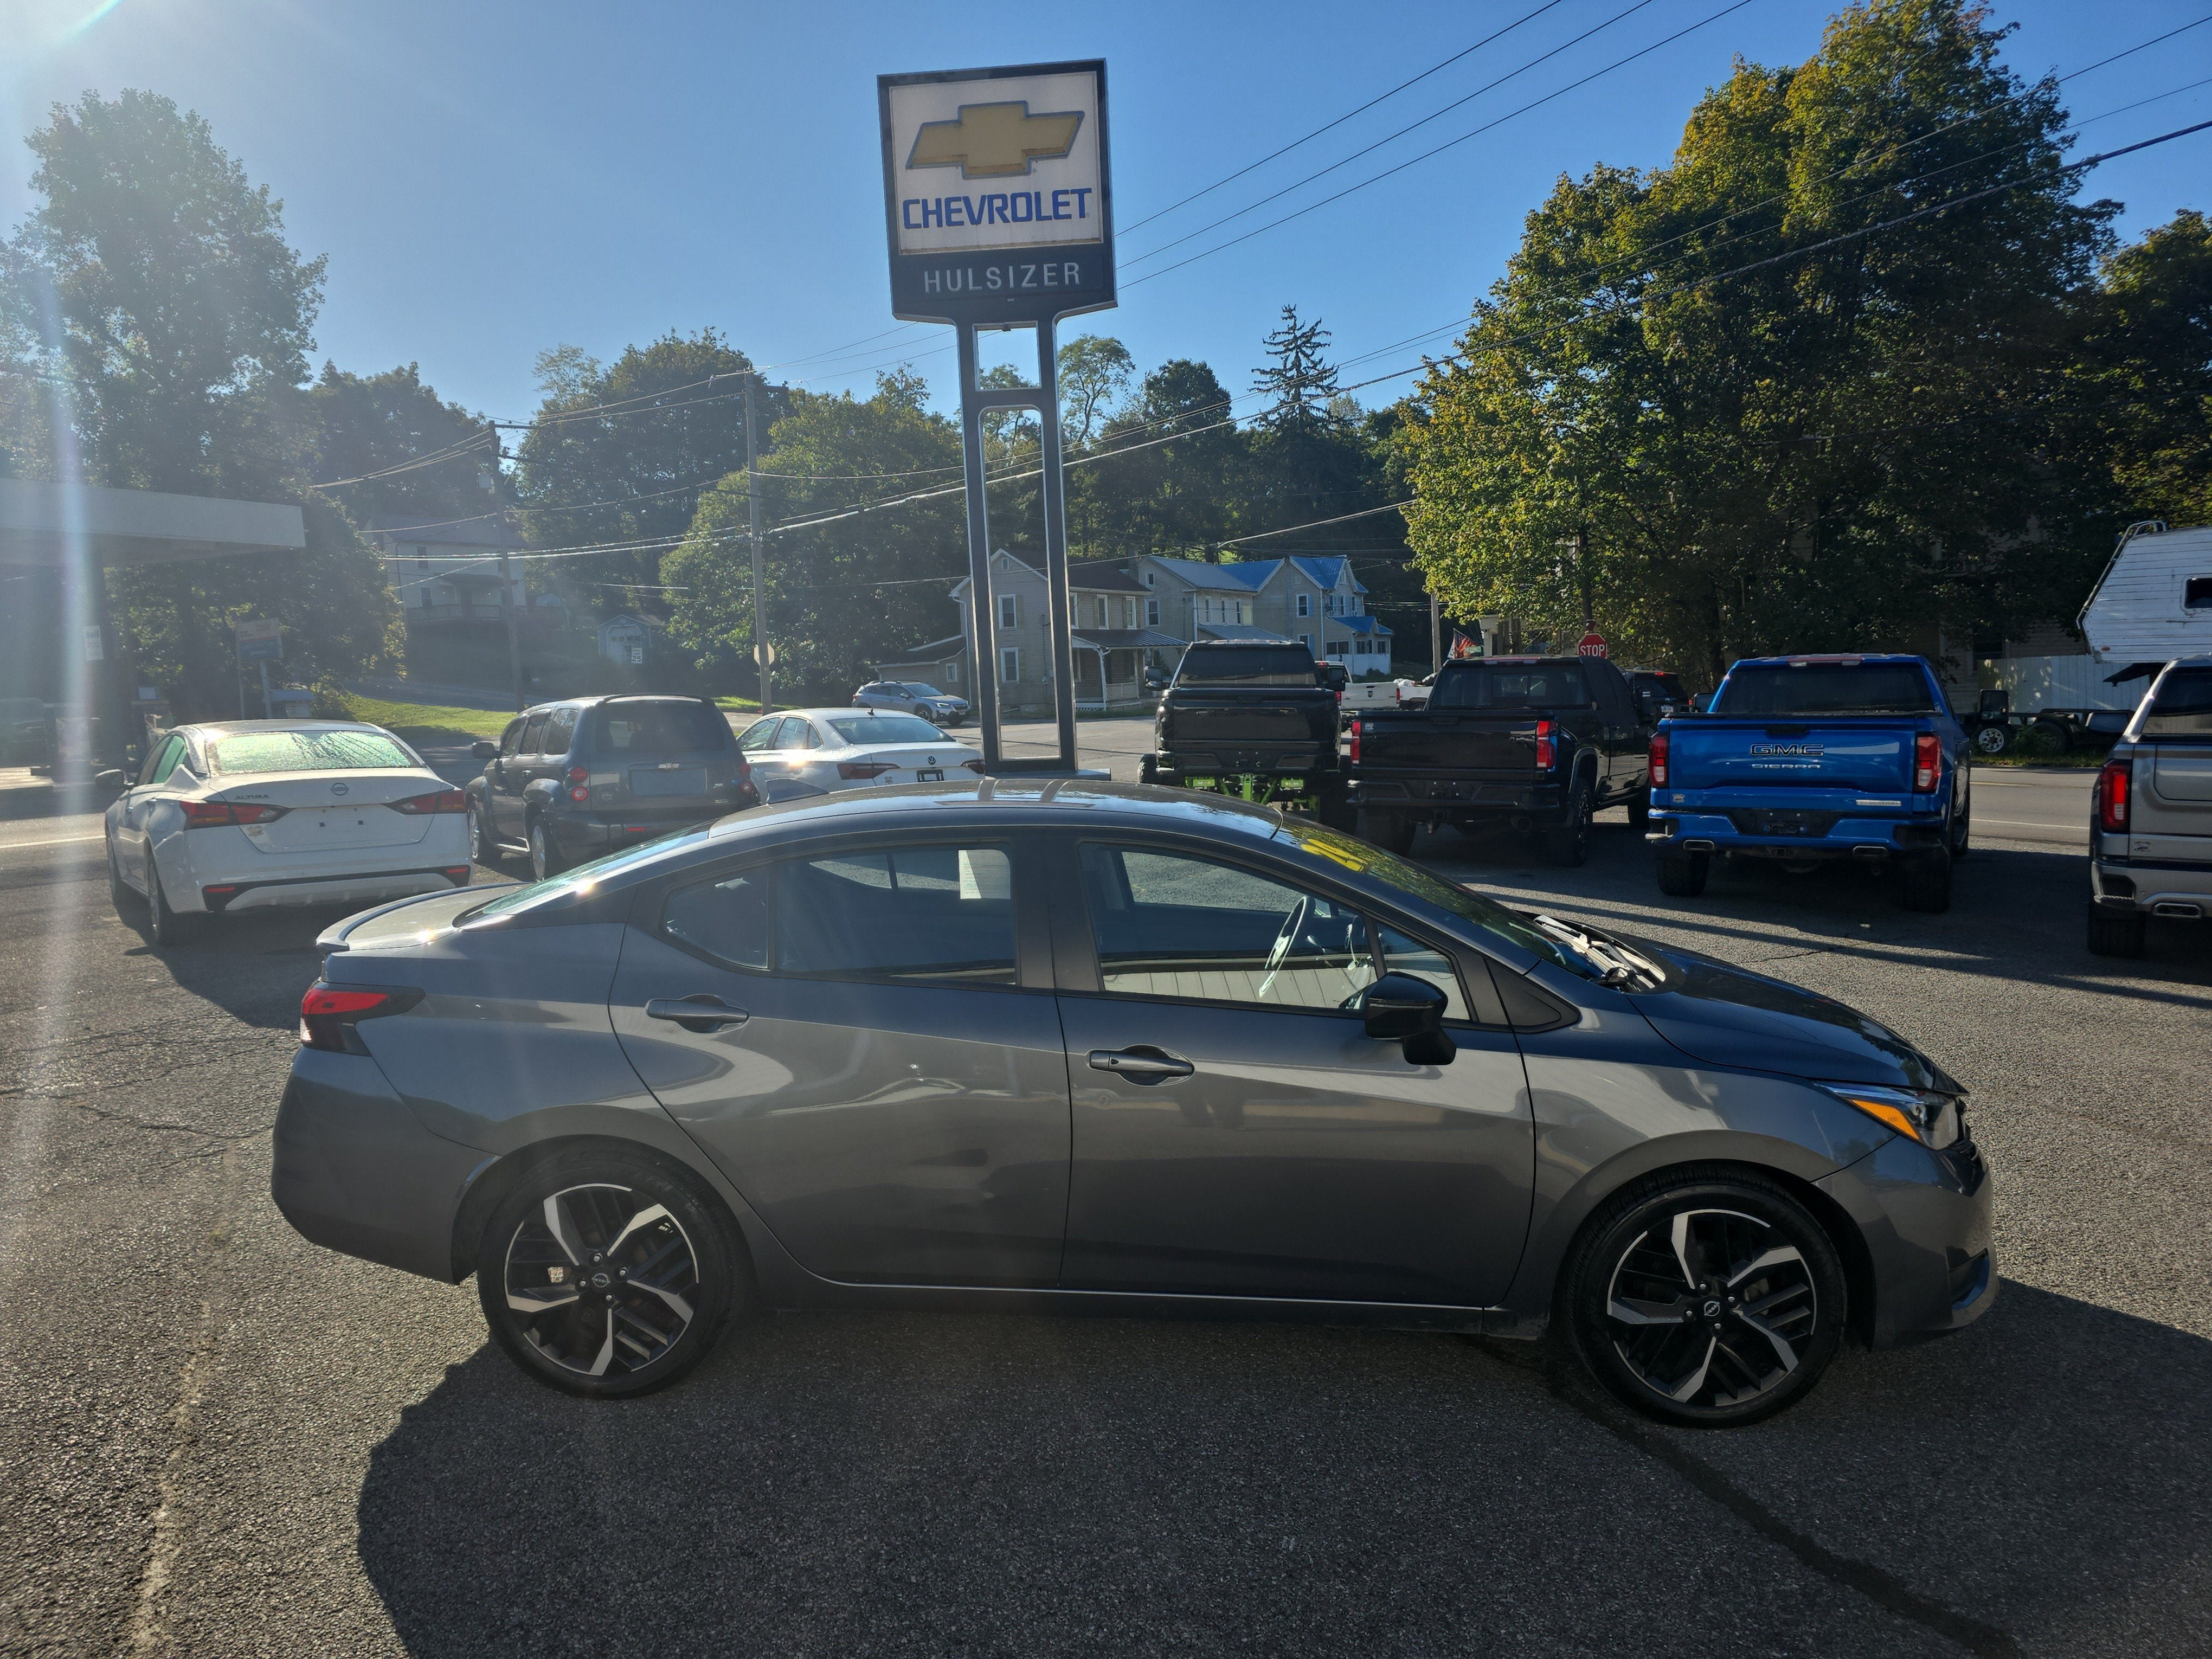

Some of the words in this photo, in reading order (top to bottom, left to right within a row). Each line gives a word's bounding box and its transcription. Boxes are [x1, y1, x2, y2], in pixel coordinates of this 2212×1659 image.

[903, 188, 1092, 230] CHEVROLET
[924, 262, 1081, 294] HULSIZER
[1580, 644, 1605, 657] STOP
[1750, 744, 1823, 756] GMC
